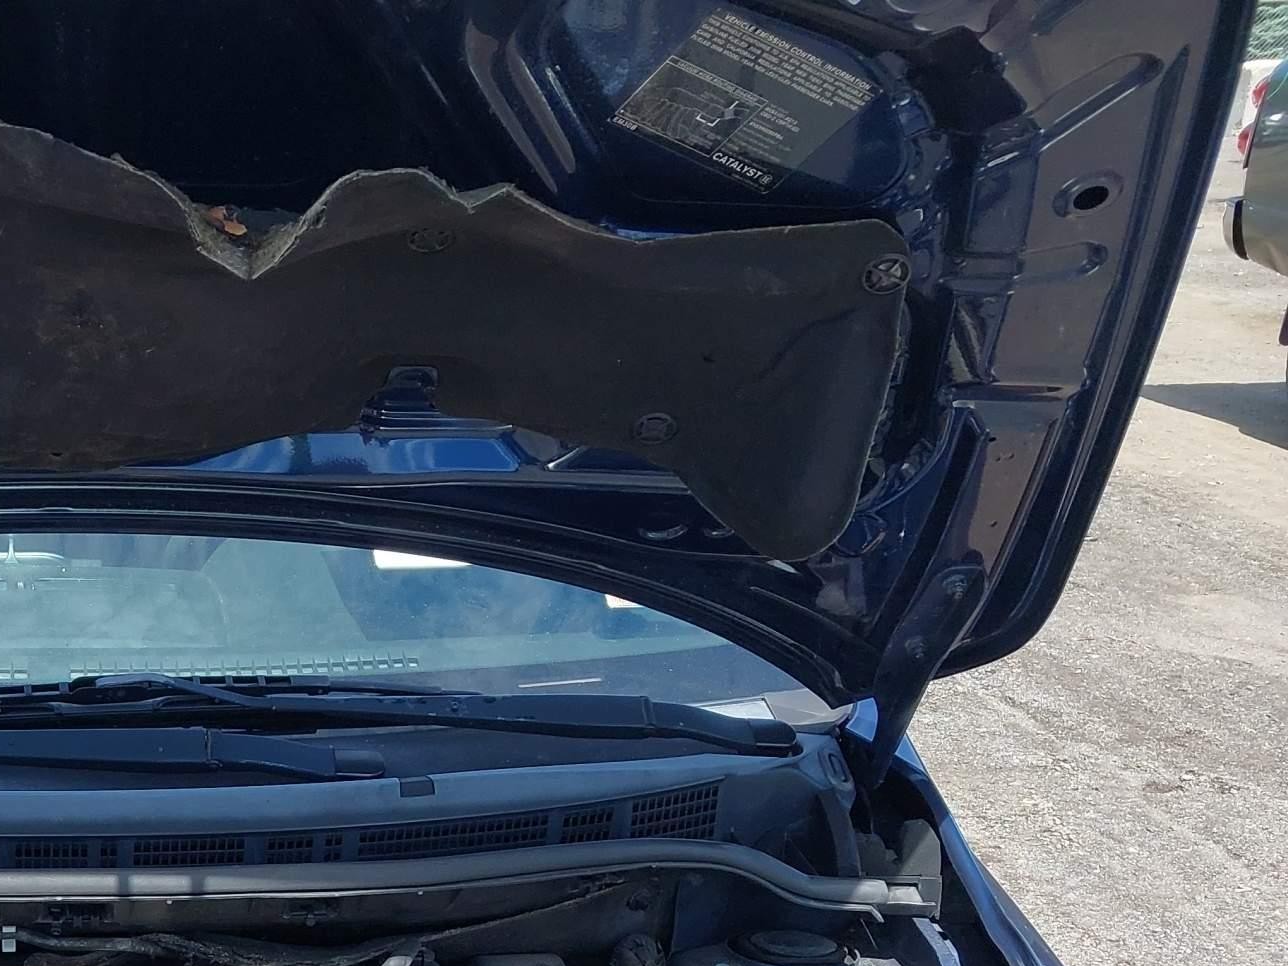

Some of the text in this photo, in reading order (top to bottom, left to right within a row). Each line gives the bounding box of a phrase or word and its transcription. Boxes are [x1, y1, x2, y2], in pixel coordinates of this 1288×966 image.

[724, 13, 757, 33] VEHICLE
[755, 29, 792, 49] EMISSION
[790, 46, 824, 67] CONTROL
[824, 63, 872, 90] INFORMATION
[712, 152, 762, 179] CATALYST
